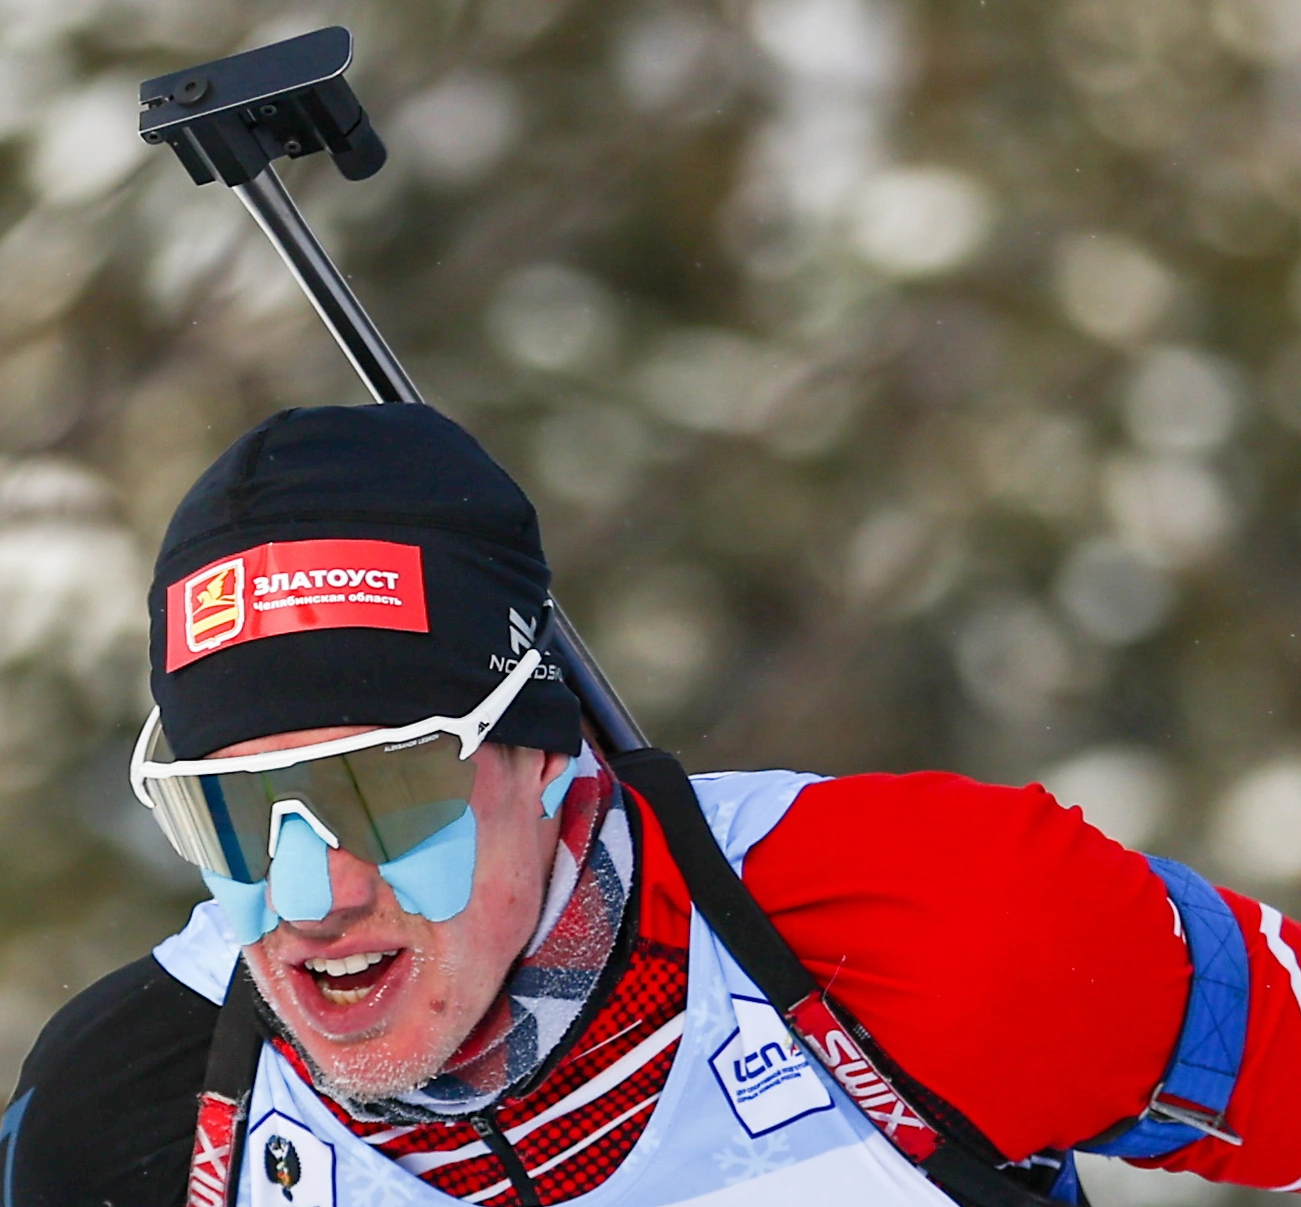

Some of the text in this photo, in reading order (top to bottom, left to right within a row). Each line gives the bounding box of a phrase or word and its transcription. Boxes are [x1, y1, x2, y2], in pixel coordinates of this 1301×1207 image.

[253, 568, 399, 596] ЗЛАТОУСТ
[253, 592, 402, 611] Челябинская область
[805, 1029, 926, 1136] SWIX
